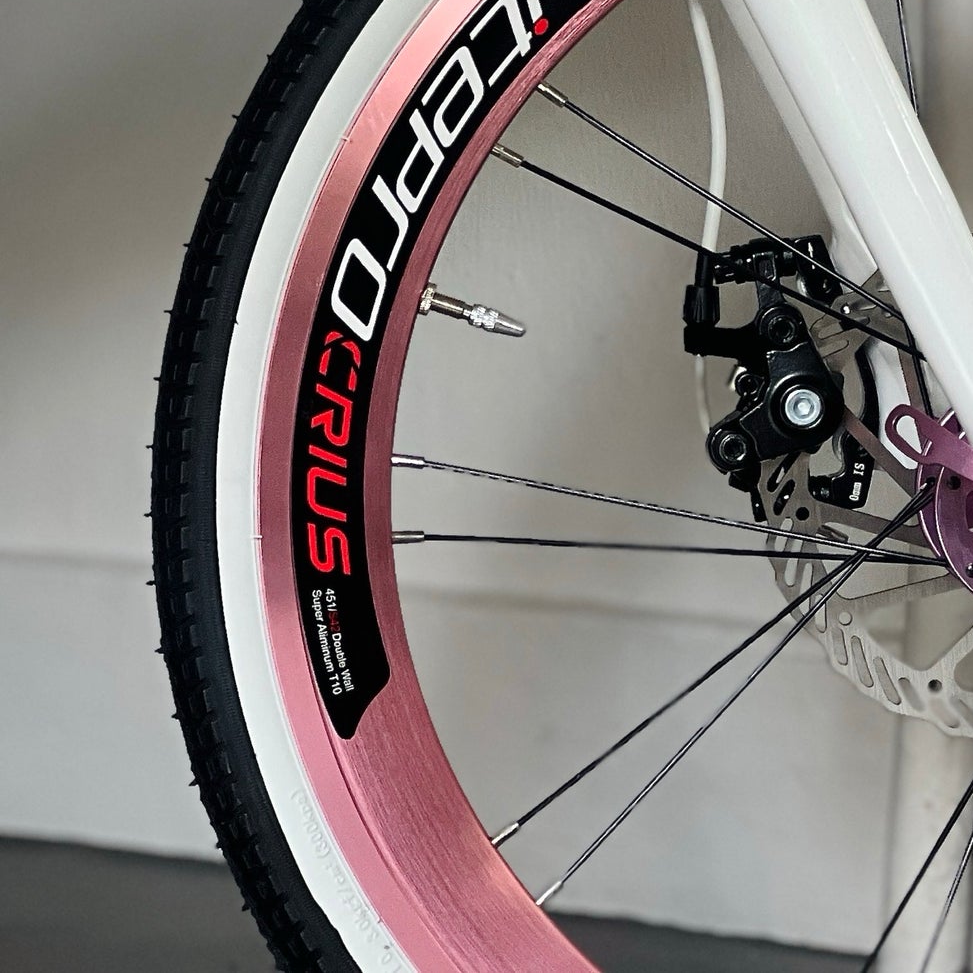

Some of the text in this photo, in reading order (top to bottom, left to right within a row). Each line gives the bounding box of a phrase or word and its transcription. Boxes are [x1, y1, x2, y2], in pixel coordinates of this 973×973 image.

[307, 331, 361, 575] CRIUS
[853, 463, 865, 476] IS
[312, 589, 324, 622] Super
[329, 673, 343, 695] T10
[341, 669, 354, 692] Wall
